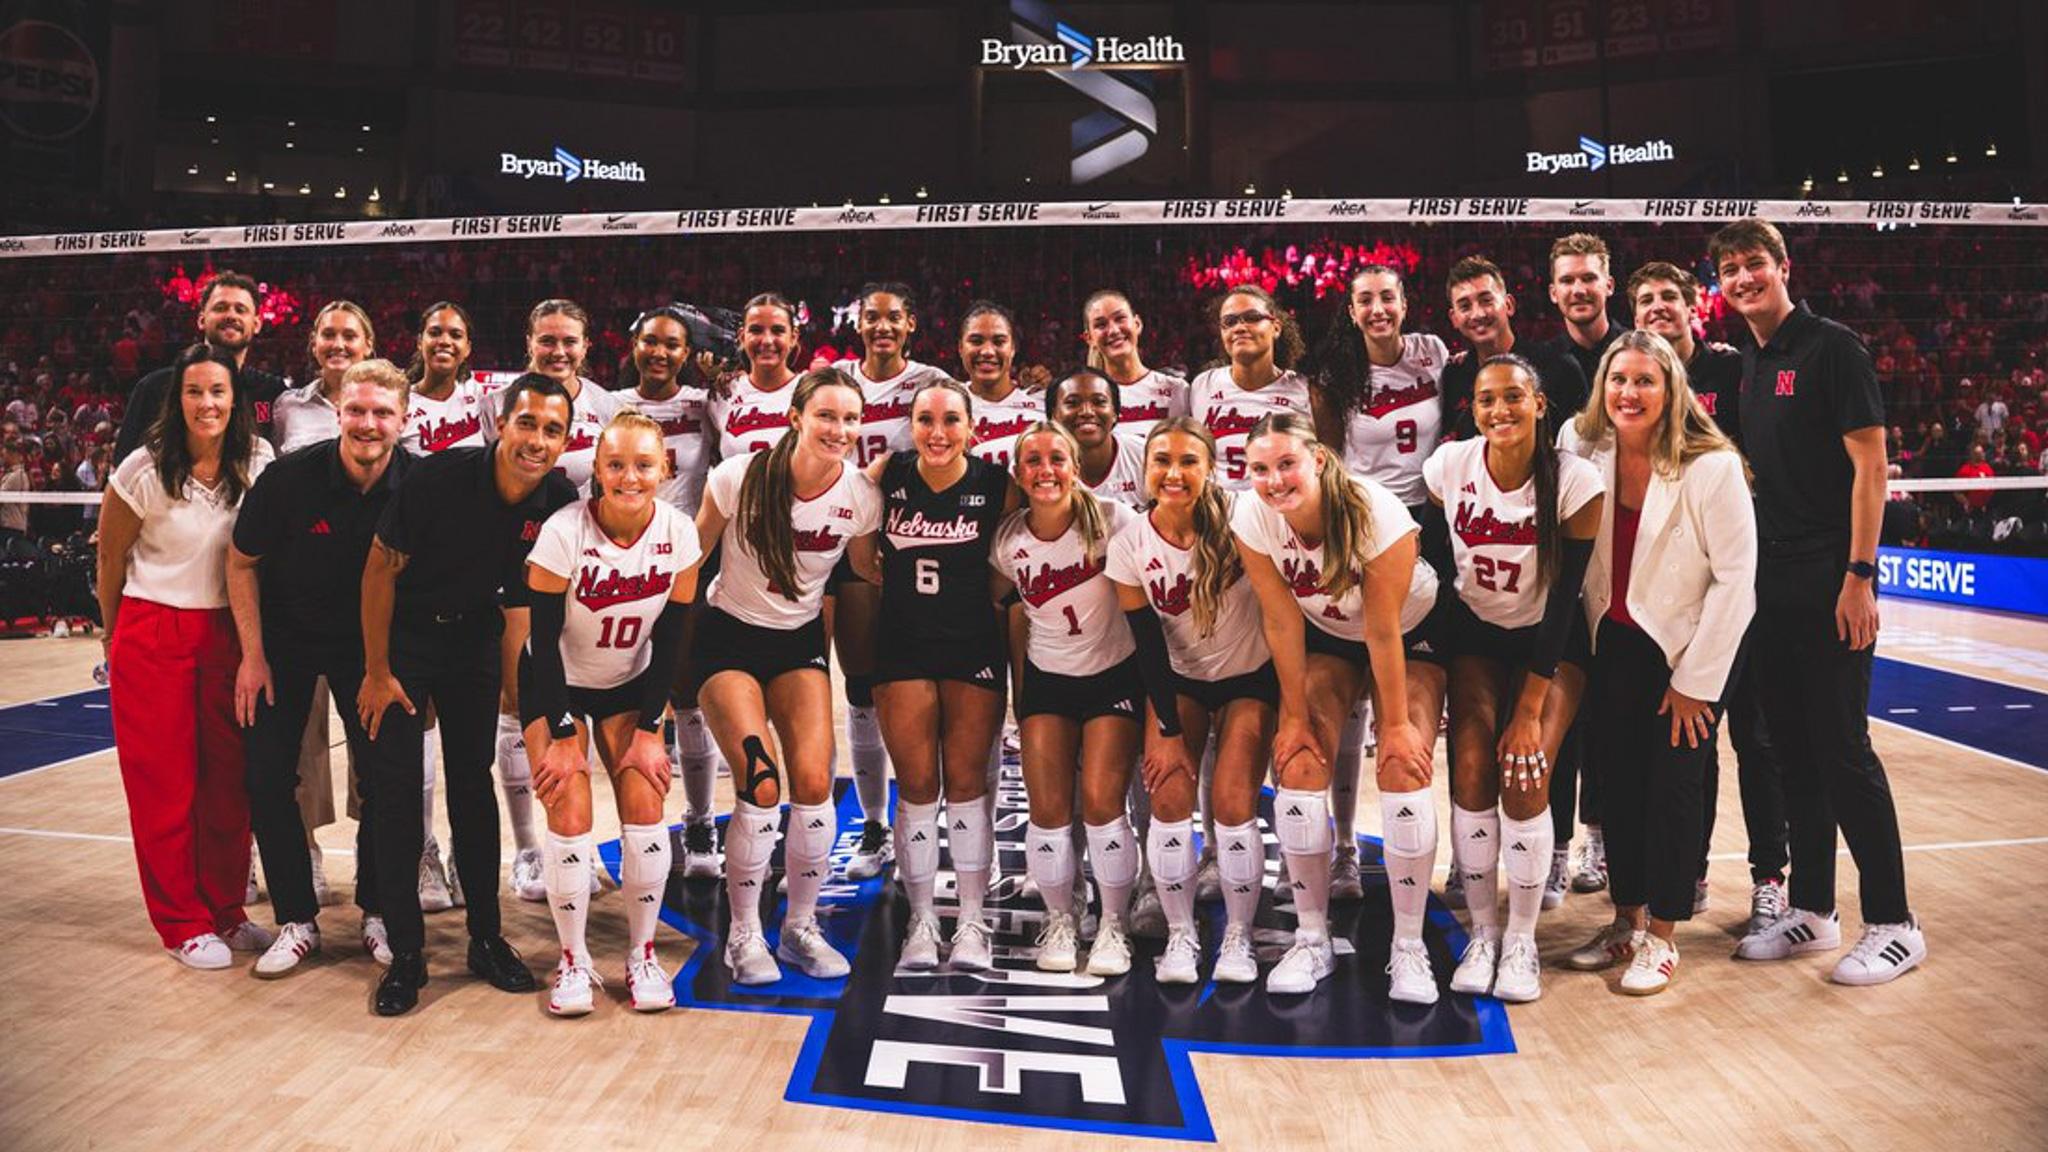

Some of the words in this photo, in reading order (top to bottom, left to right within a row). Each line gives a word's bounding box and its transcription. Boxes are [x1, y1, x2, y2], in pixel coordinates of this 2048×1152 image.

[981, 38, 1068, 69] Bryan
[1096, 36, 1185, 62] Health
[501, 153, 563, 179] Bryan
[583, 159, 645, 182] Health
[1526, 151, 1588, 174] Bryan
[1609, 139, 1674, 164] Health
[677, 210, 731, 228] FIRST
[736, 208, 797, 227] SERVE
[916, 204, 972, 222] FIRST
[978, 203, 1040, 221] SERVE
[1162, 201, 1219, 218] FIRST
[1224, 199, 1287, 217] SERVE
[1407, 199, 1462, 216] FIRST
[1468, 198, 1531, 216] SERVE
[1644, 200, 1697, 216] FIRST
[1702, 200, 1759, 217] SERVE
[1867, 202, 1915, 218] FIRST
[1920, 201, 1973, 219] SERVE
[243, 226, 289, 243] FIRST
[293, 223, 345, 241] SERVE
[452, 217, 502, 235] FIRST
[506, 215, 563, 234] SERVE
[55, 236, 95, 250] FIRST
[100, 232, 147, 248] SERVE
[1776, 370, 1796, 396] N
[256, 401, 270, 422] N
[857, 435, 887, 468] 12
[1396, 419, 1418, 454] 9
[1226, 446, 1248, 480] 5
[885, 507, 979, 546] Nebraska
[576, 564, 673, 610] Nebraska
[915, 558, 940, 595] 6
[1473, 554, 1522, 593] 27
[1906, 557, 1975, 595] SERVE
[596, 616, 643, 649] 10
[1062, 604, 1082, 636] 1
